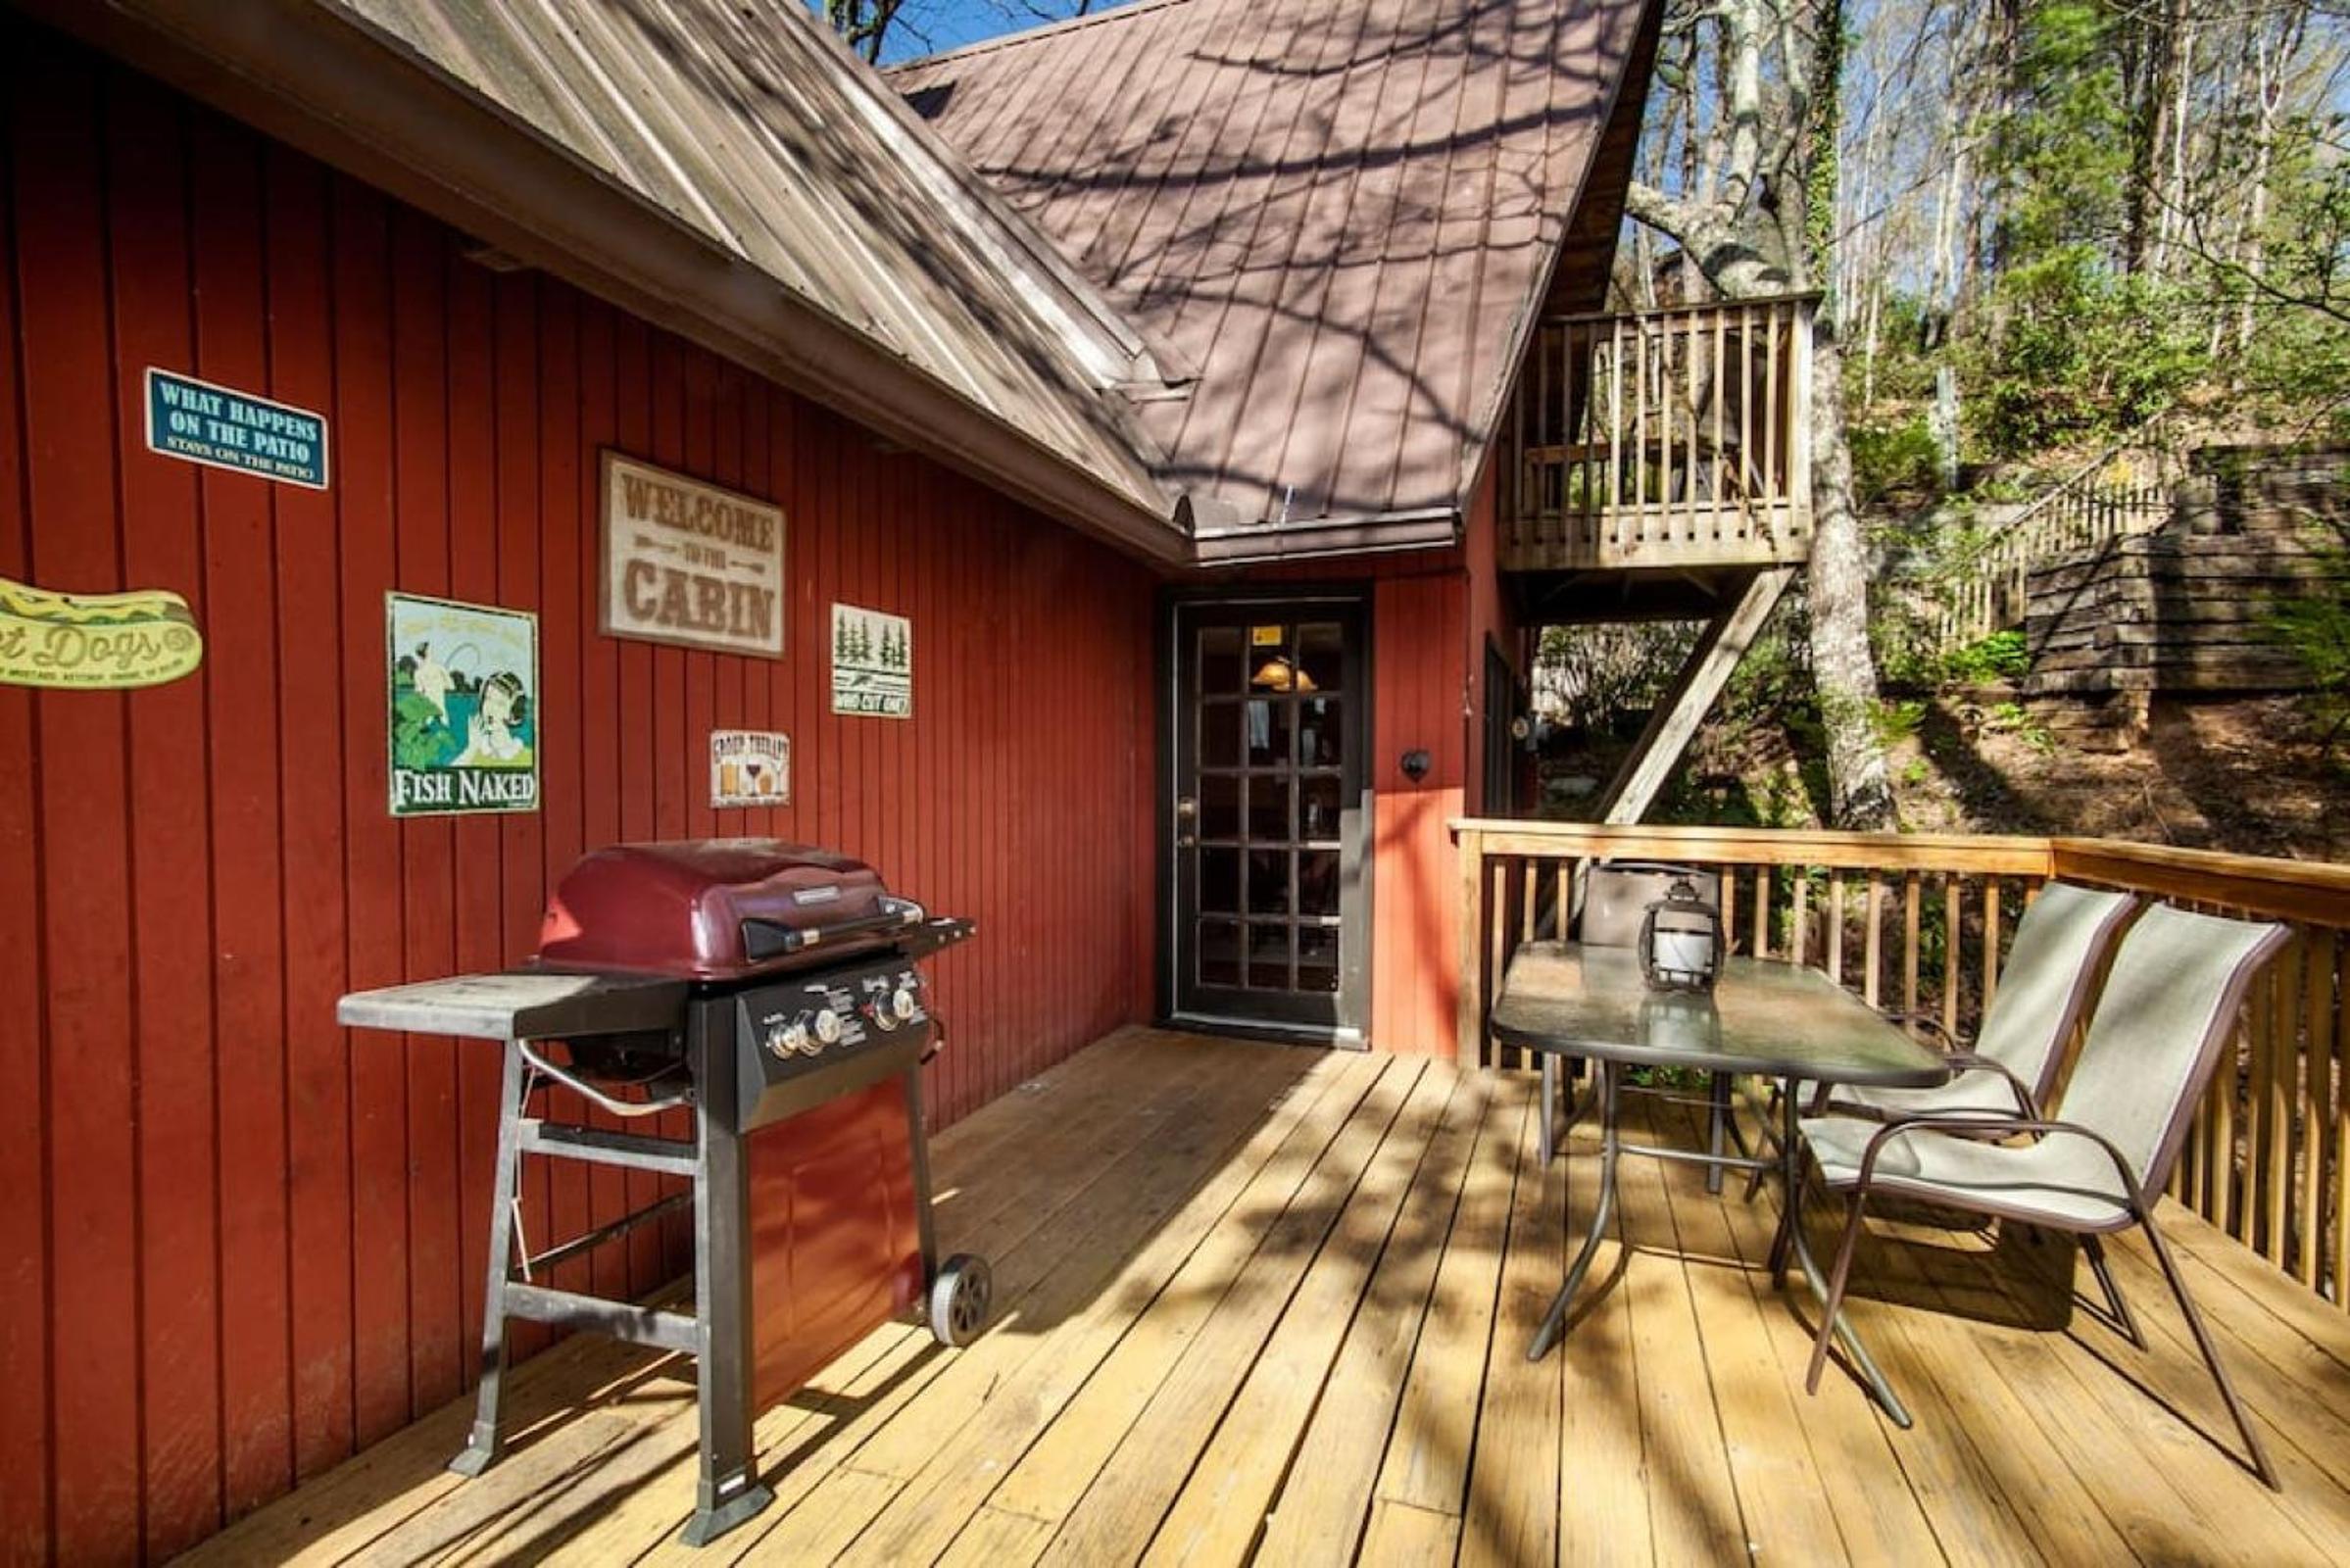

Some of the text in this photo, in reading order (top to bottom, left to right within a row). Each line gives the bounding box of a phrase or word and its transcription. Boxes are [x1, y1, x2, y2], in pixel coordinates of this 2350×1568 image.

[160, 381, 317, 442] WHAT HAPPENS
[170, 411, 311, 464] ON THE PATIO
[167, 435, 315, 480] STAYS ON THE PATIO
[621, 472, 774, 553] WELCOME
[623, 558, 775, 641] CABIN
[32, 626, 161, 670] Dogs
